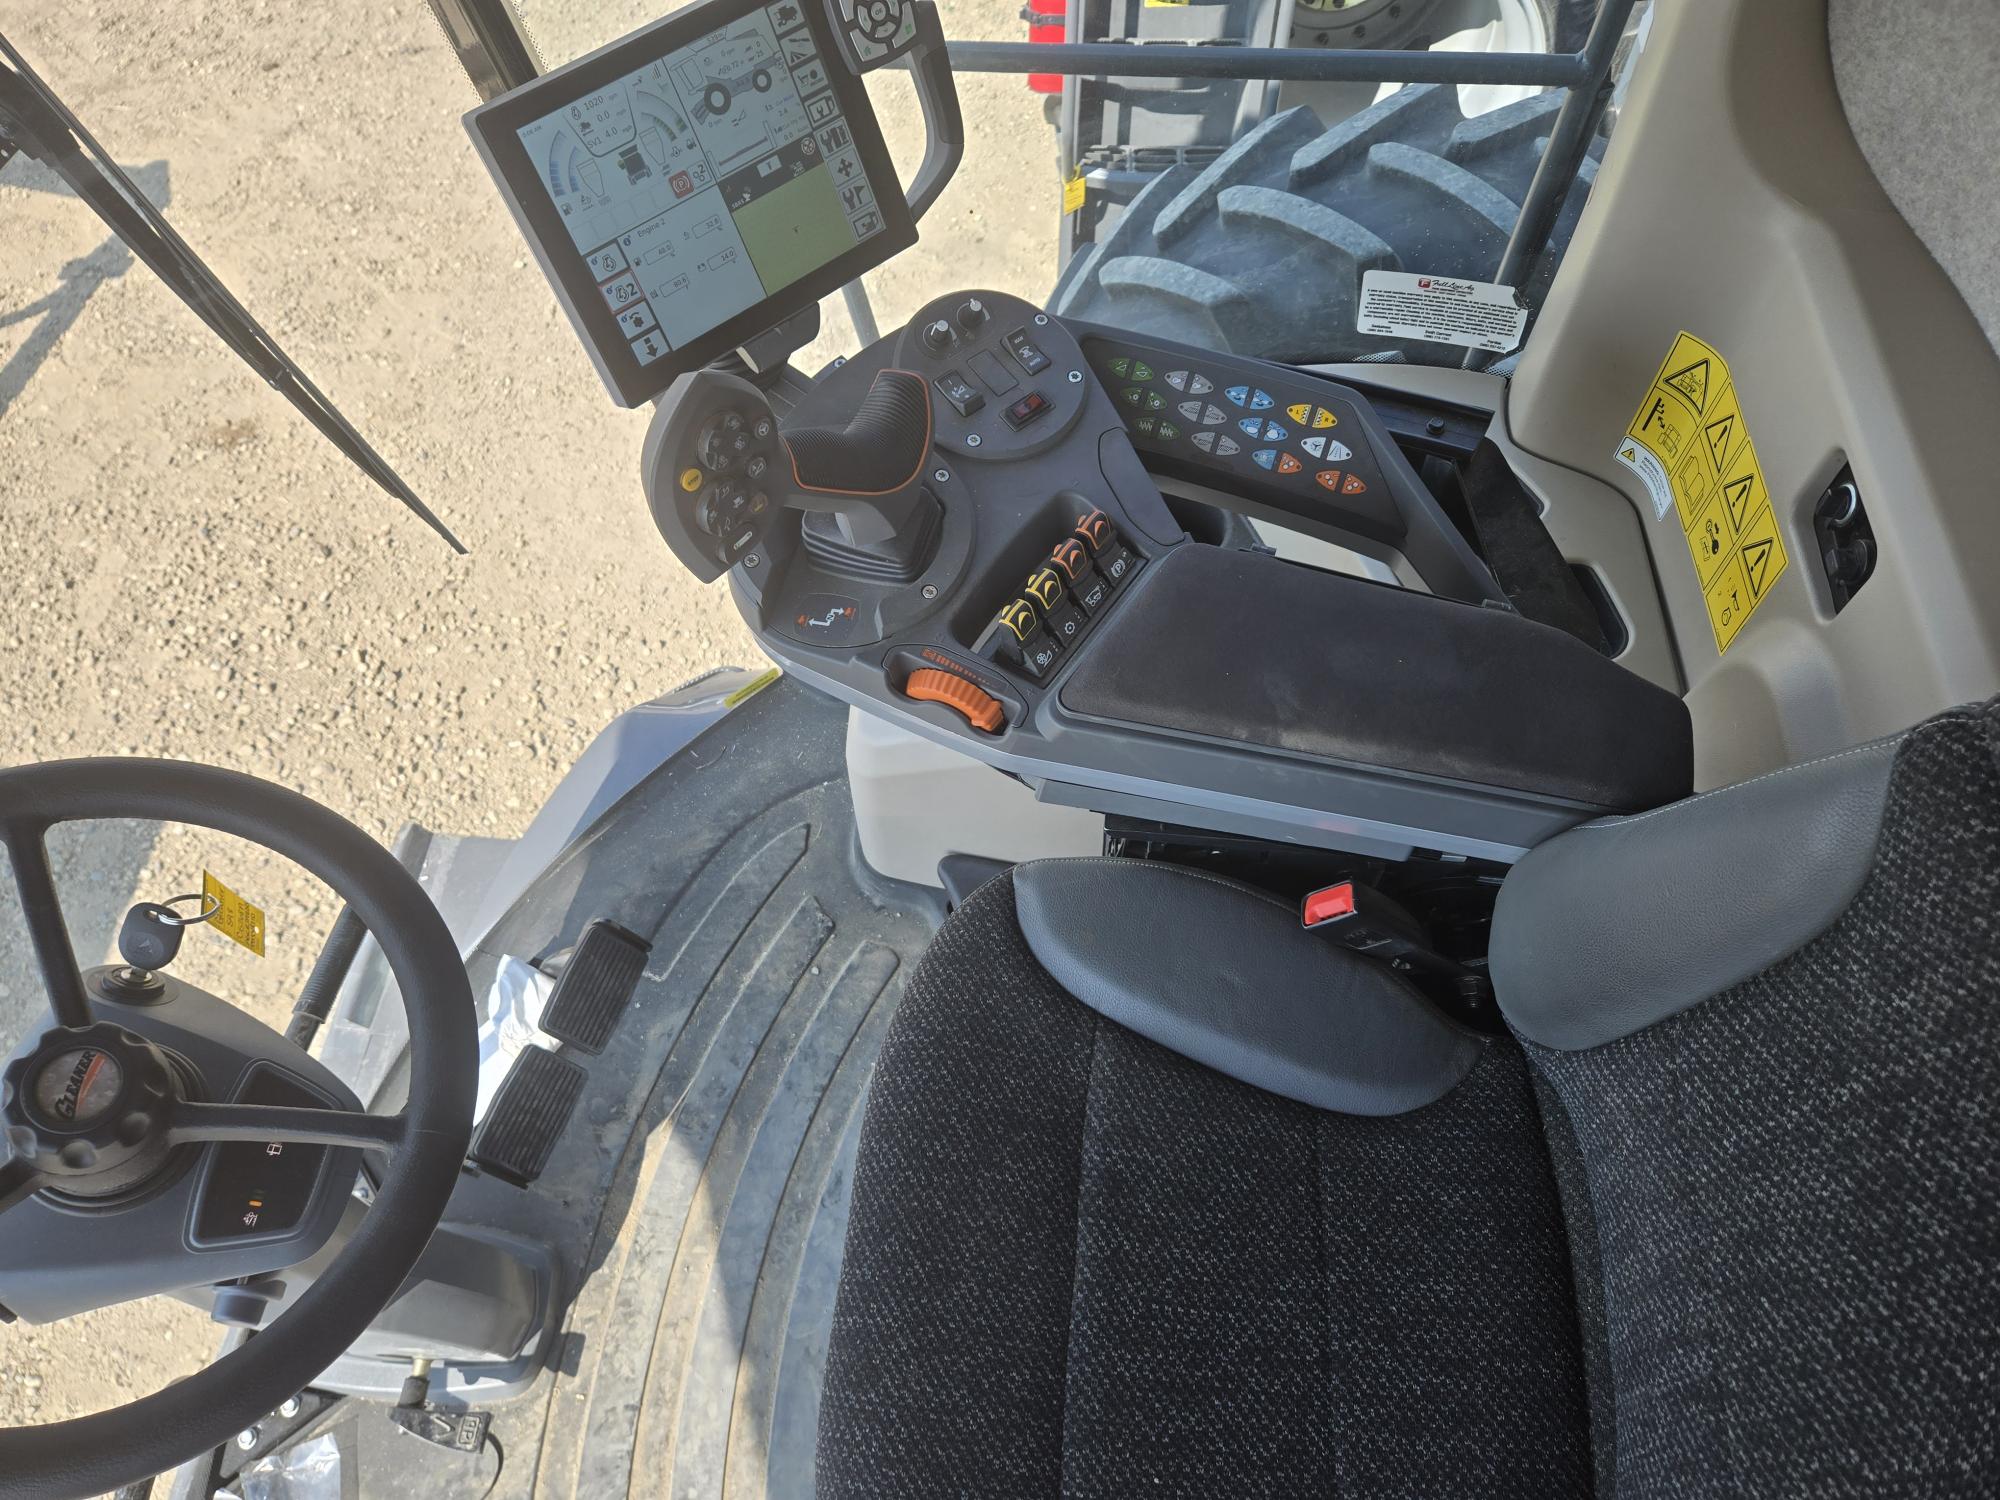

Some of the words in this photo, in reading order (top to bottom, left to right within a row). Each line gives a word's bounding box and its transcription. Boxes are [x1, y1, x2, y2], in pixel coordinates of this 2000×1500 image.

[584, 95, 604, 111] 1020
[597, 110, 610, 122] 0.0
[587, 137, 602, 150] SV1
[605, 126, 618, 138] 4.0
[637, 222, 660, 238] Engine
[626, 282, 638, 297] 2
